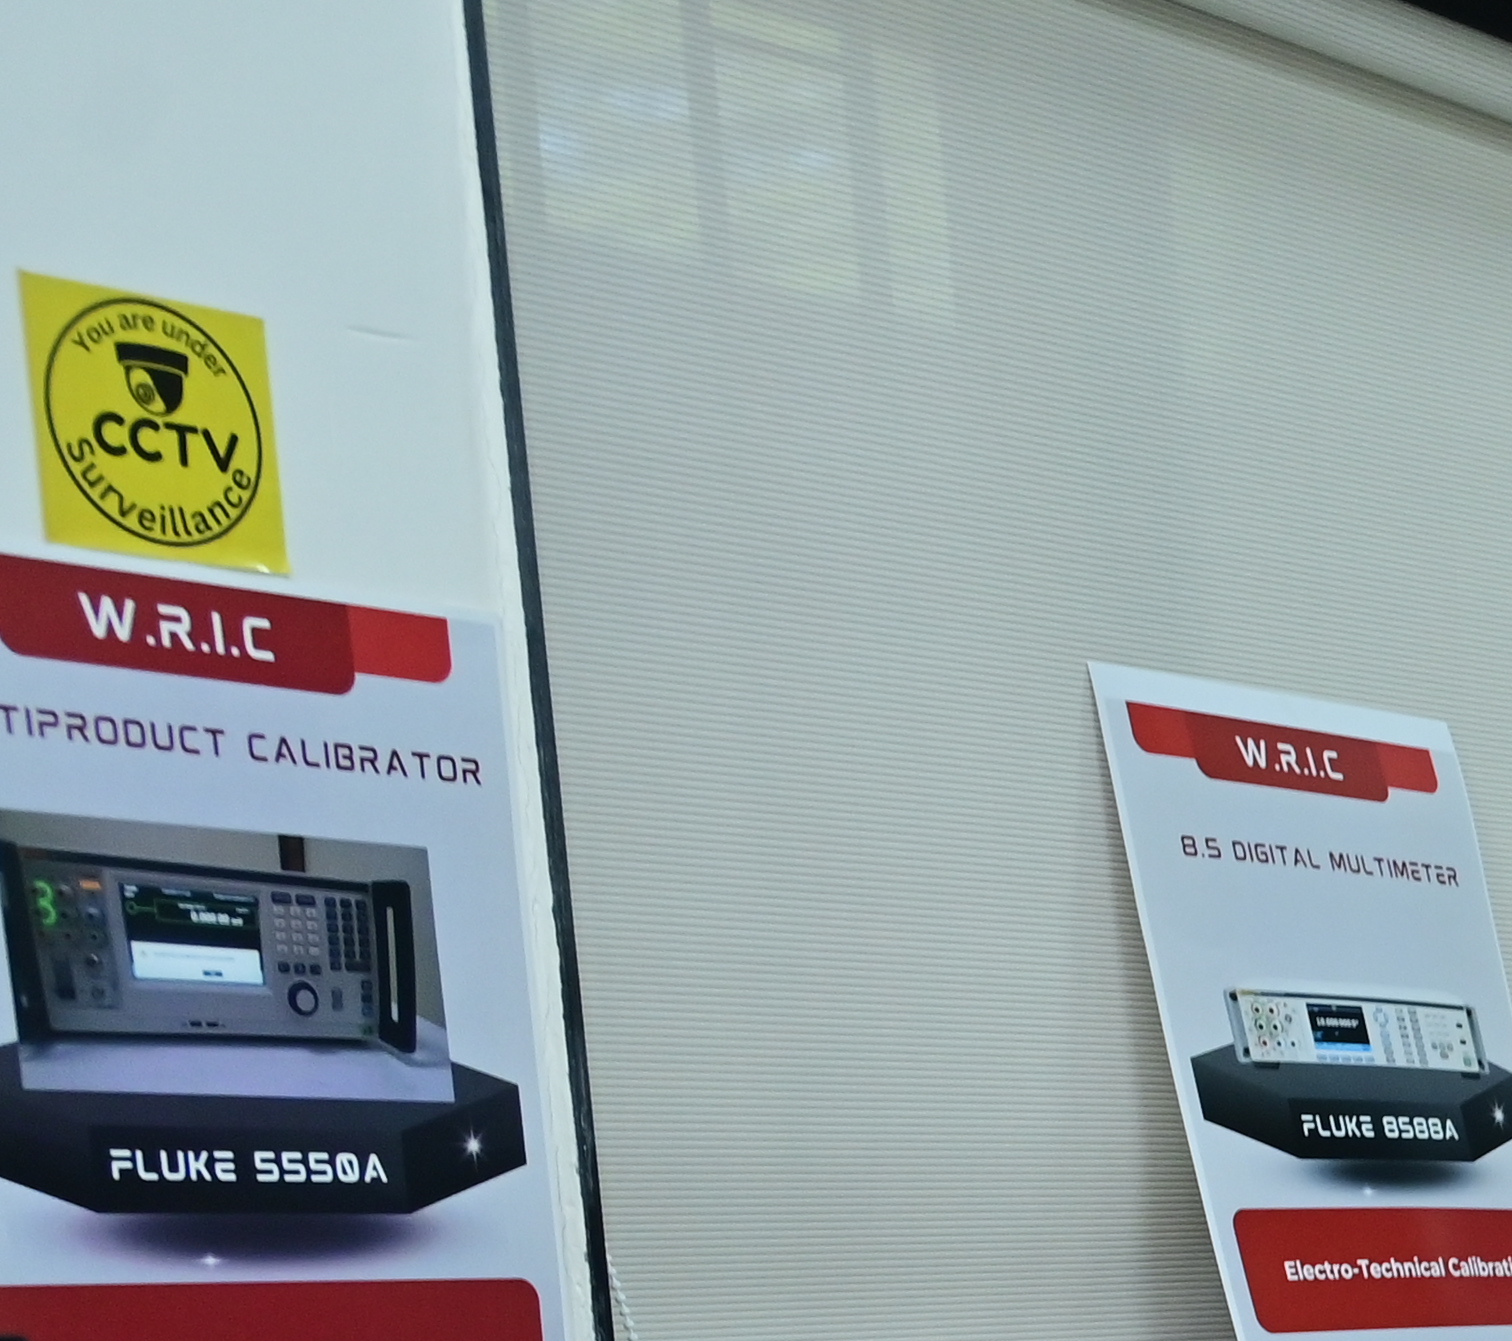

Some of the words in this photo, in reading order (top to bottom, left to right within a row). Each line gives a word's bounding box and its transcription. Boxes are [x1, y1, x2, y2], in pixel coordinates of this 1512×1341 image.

[71, 317, 115, 354] You
[119, 311, 155, 333] are
[162, 321, 227, 378] under
[93, 412, 240, 473] CCTV
[66, 437, 252, 537] Surveillance
[77, 591, 276, 664] W.R.I.C
[0, 704, 225, 757] TIPRODUCT
[247, 733, 482, 786] CALIBRATOR
[1235, 735, 1344, 781] W.R.I.C
[1180, 834, 1222, 859] 8.5
[1231, 840, 1321, 870] DIGITAL
[1329, 851, 1459, 887] MULTIMETER
[1301, 1114, 1375, 1138] FLUKE
[1382, 1115, 1460, 1142] 8588A
[109, 1148, 237, 1183] FLUKE
[254, 1150, 389, 1184] 5550A
[1284, 1255, 1446, 1282] Electro-Technical
